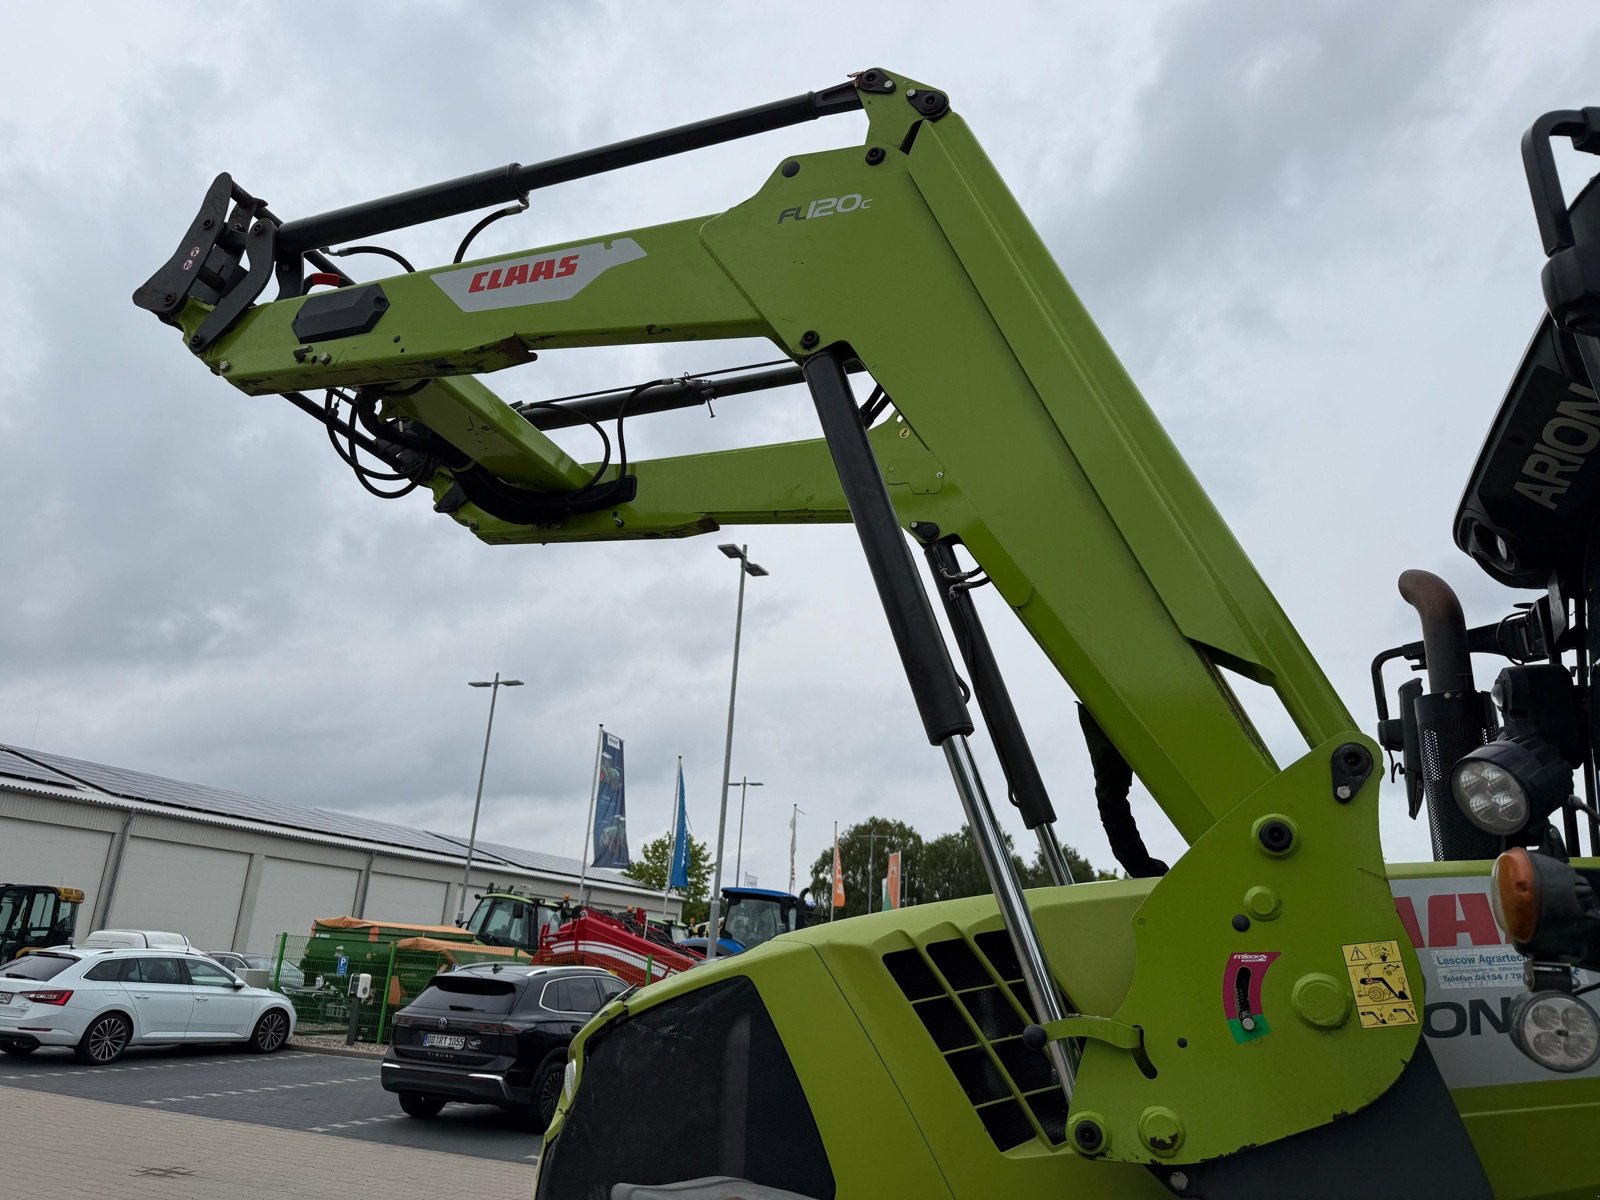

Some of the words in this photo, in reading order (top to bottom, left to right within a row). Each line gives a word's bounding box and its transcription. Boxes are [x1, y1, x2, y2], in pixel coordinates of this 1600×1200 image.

[468, 254, 580, 294] CLAAS
[1513, 382, 1600, 511] ARION
[1436, 955, 1476, 966] Lescow
[1442, 974, 1473, 984] Telefon
[1475, 973, 1503, 982] 04154
